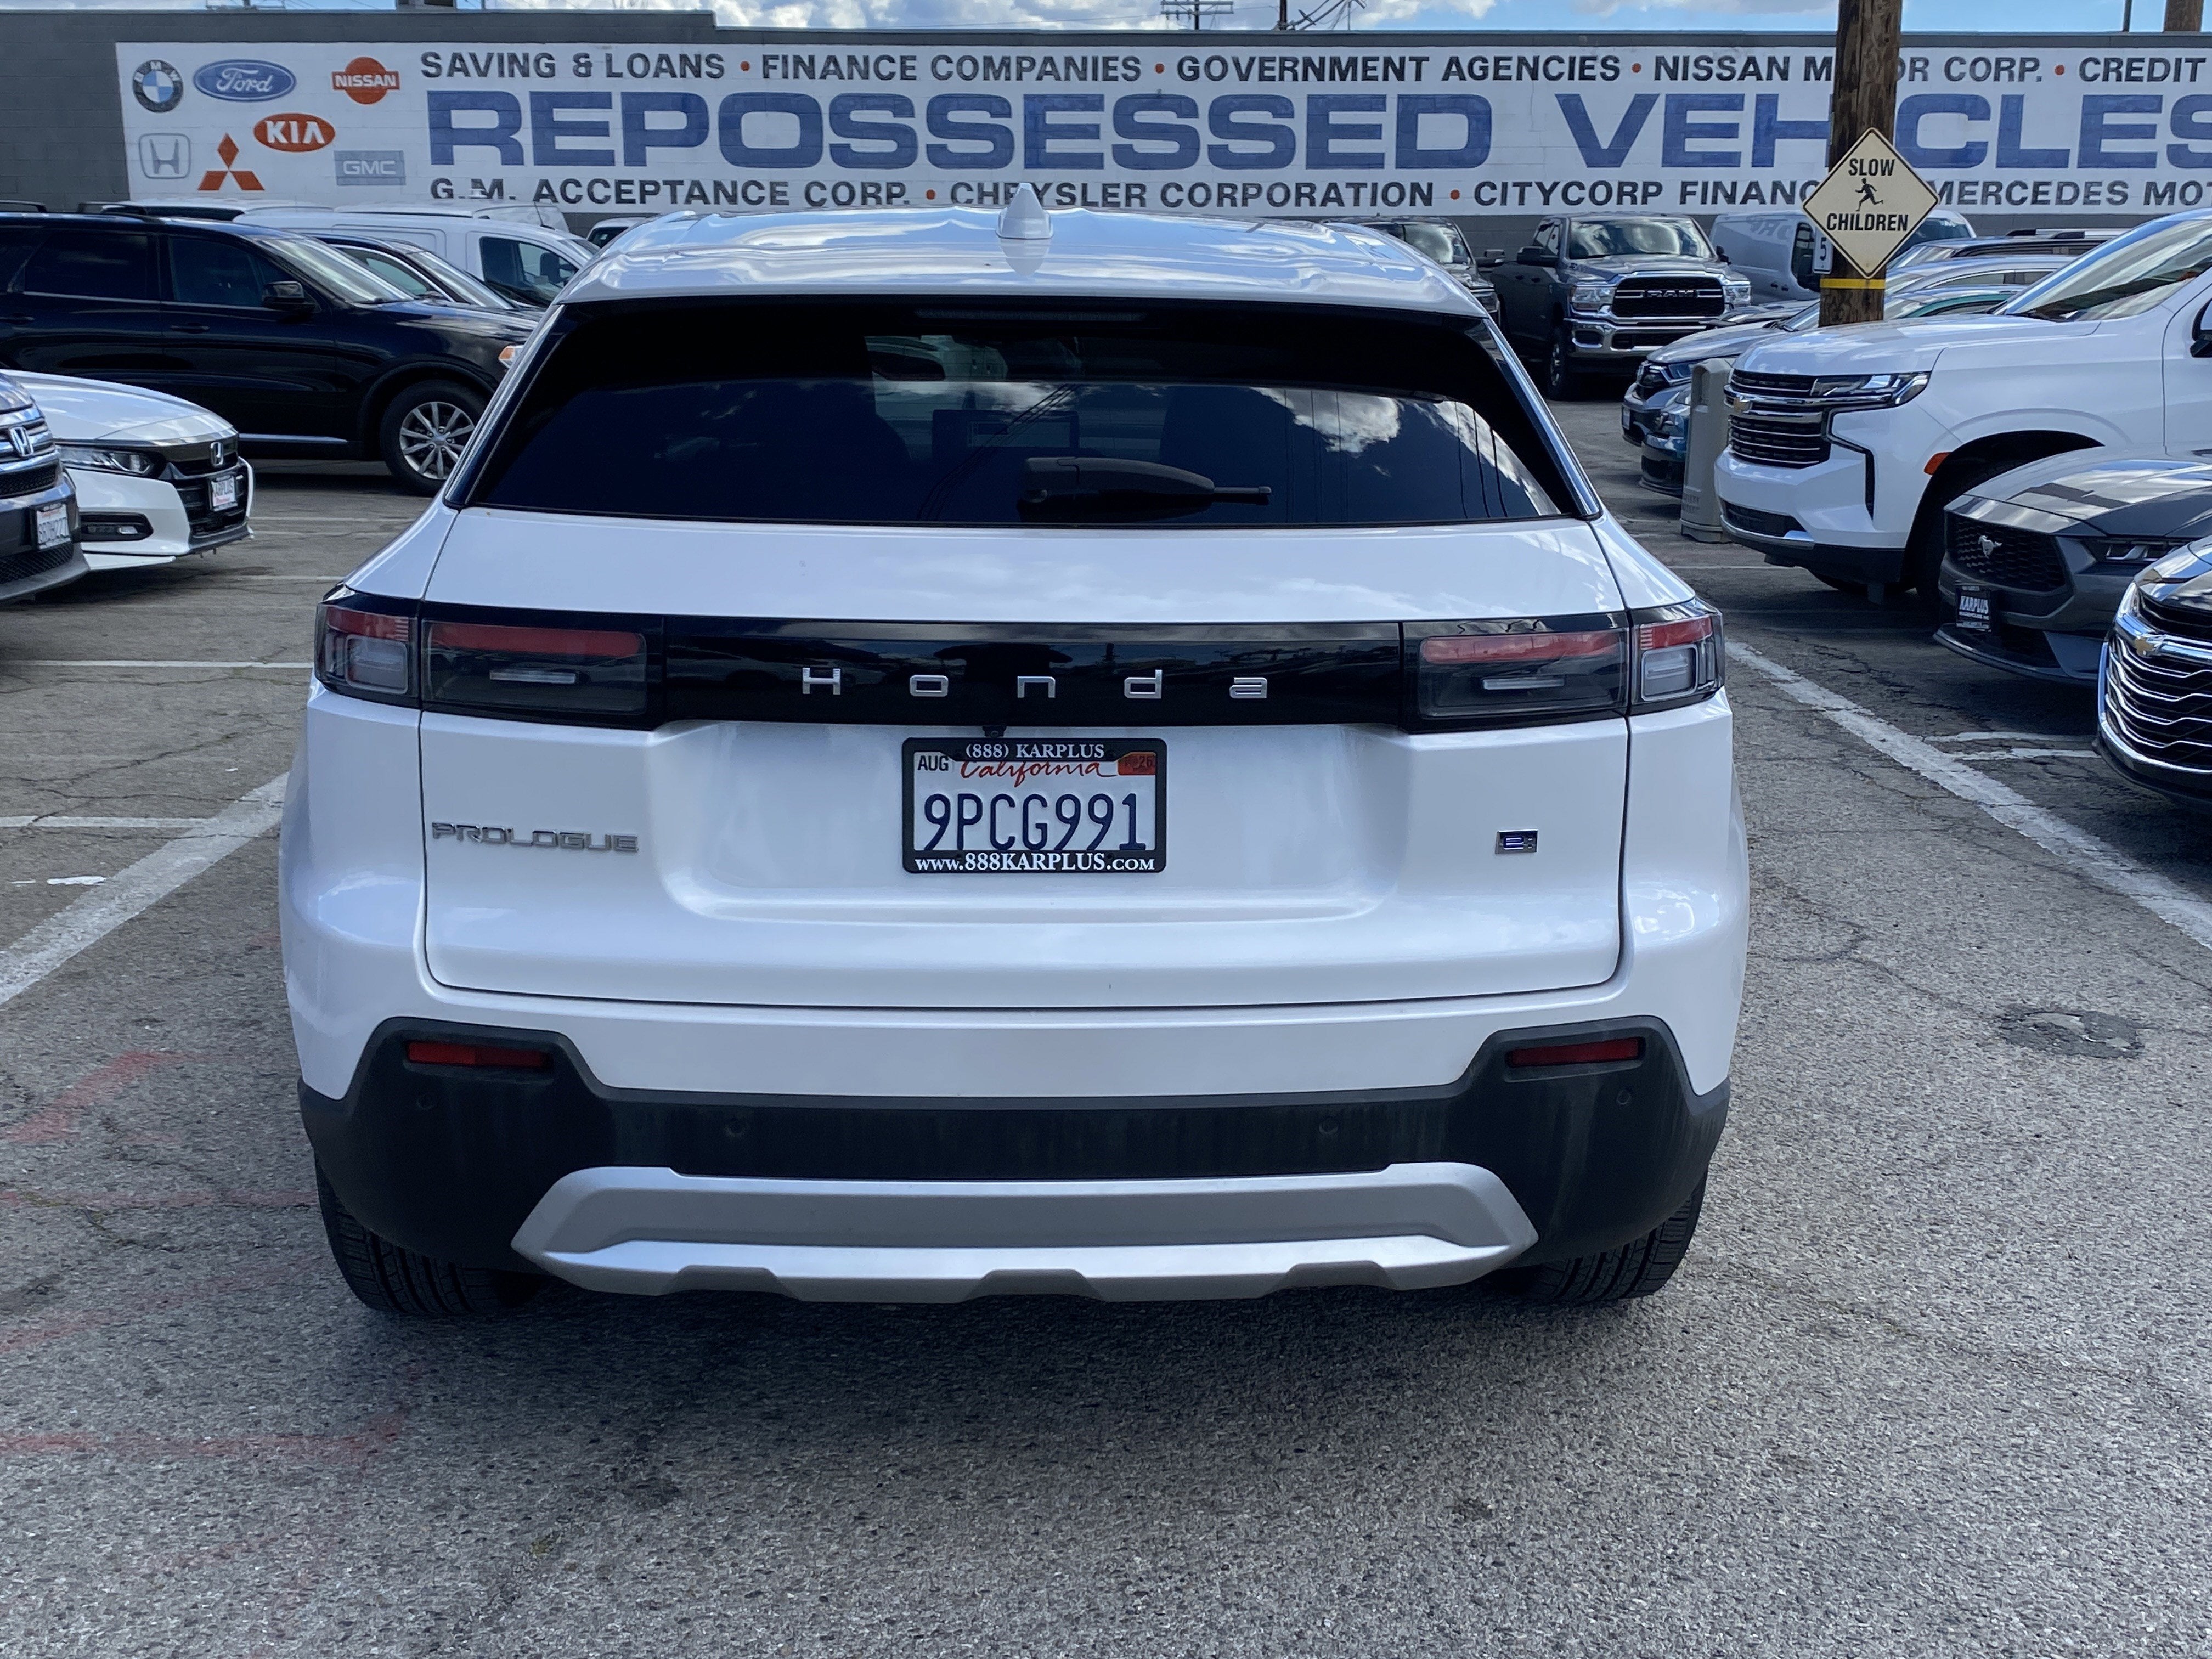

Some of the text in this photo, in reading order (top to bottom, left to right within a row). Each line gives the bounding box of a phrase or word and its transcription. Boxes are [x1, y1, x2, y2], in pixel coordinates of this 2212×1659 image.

[134, 60, 182, 83] BMW
[216, 67, 273, 93] Ford
[421, 52, 556, 78] SAVING
[572, 53, 593, 78] &
[606, 53, 725, 79] LOANS
[762, 54, 917, 81] FINANCE
[931, 55, 1142, 82] COMPANIES
[1177, 55, 1430, 82] GOVERNMENT
[1441, 55, 1621, 81] AGENCIES
[1654, 55, 1790, 81] NISSAN
[1943, 56, 2042, 83] CORP.
[2079, 57, 2206, 83] CREDIT
[335, 74, 397, 88] NISSAN
[264, 120, 325, 144] KIA
[427, 90, 2212, 170] REPOSSESSED VEHCLES
[342, 160, 397, 176] GMC
[1848, 157, 1895, 177] SLOW
[533, 178, 789, 205] ACCEPTANCE
[804, 180, 910, 207] CORP.
[1160, 182, 1433, 208] CORPORATION
[1474, 180, 1663, 206] CITYCORP
[1927, 180, 2129, 206] MERCEDES
[2143, 180, 2212, 206] MO
[1827, 212, 1909, 231] CHILDREN
[802, 667, 1268, 699] Honda
[917, 755, 949, 771] AUG
[966, 743, 1105, 758] (888) KARPLUS
[960, 761, 1118, 787] California
[923, 793, 1147, 851] 9PCG991
[432, 821, 639, 853] PROLOGUE
